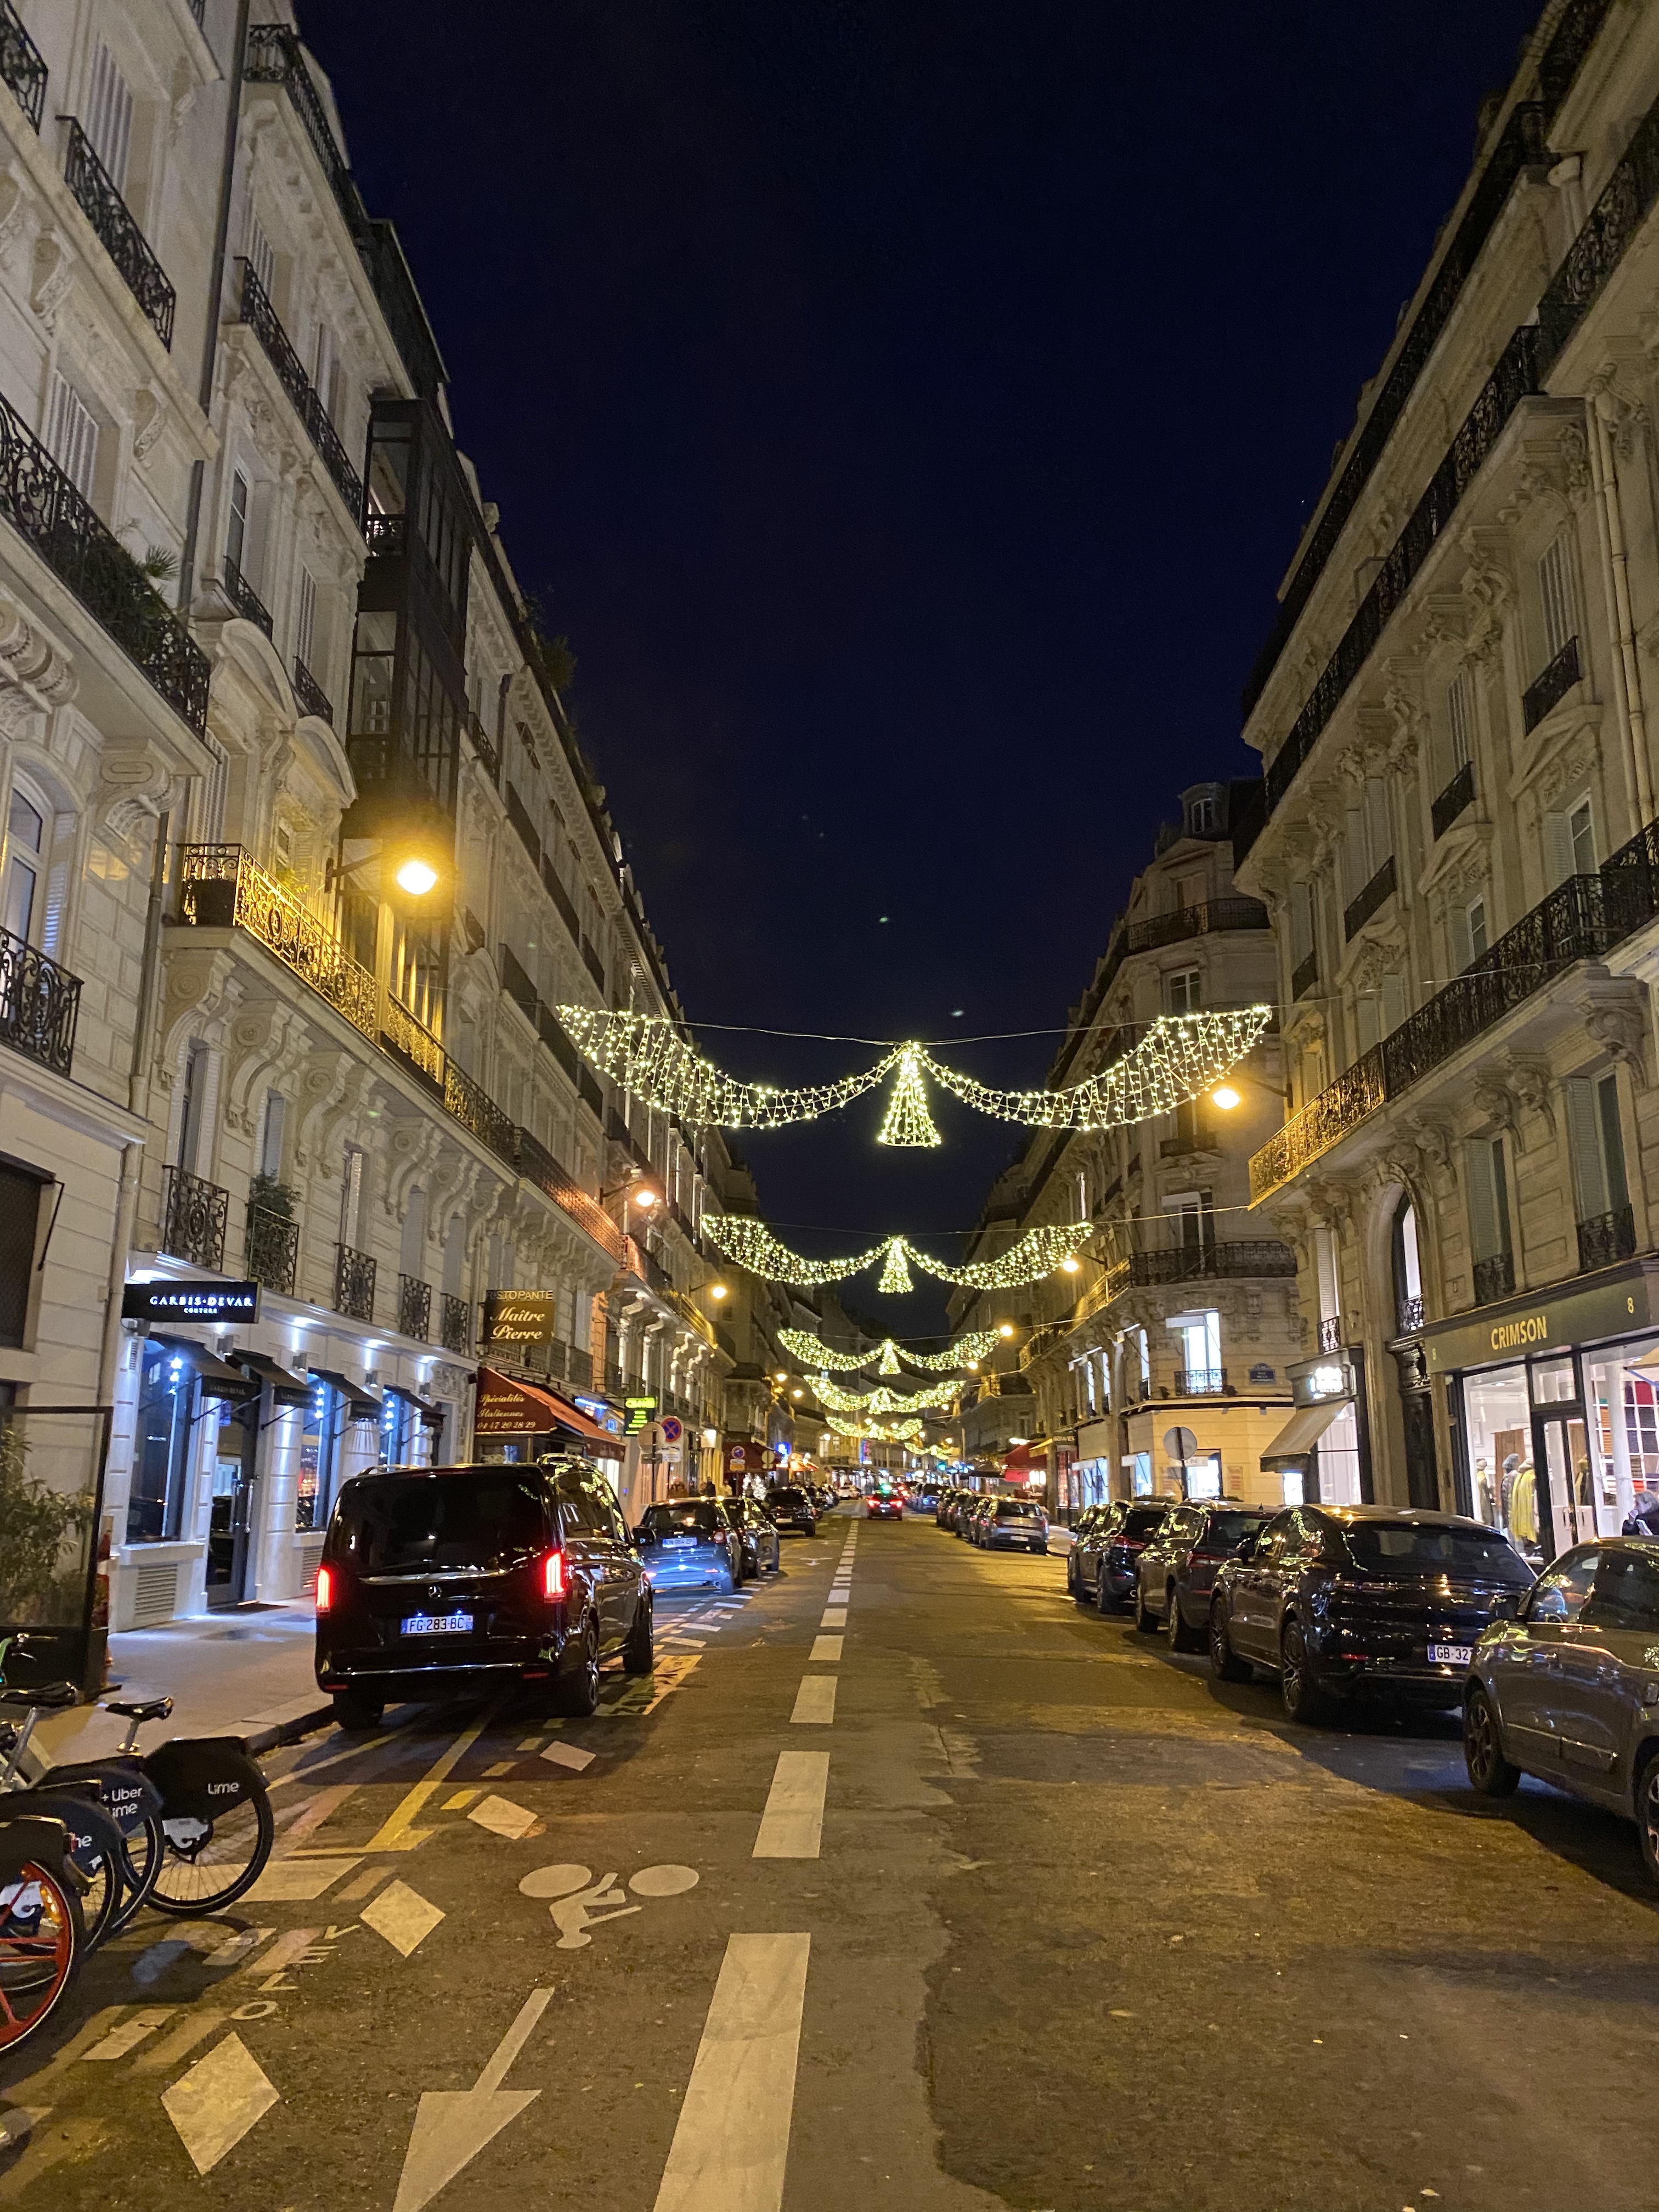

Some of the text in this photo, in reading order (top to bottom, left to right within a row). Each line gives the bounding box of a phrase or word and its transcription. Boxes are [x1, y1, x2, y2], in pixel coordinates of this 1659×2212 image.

[1627, 1297, 1634, 1313] 8
[490, 1307, 545, 1322] Maître
[490, 1324, 543, 1339] Pierre
[1491, 1316, 1548, 1350] CRIMSON
[409, 1617, 464, 1632] FG-283-BC
[1437, 1647, 1469, 1661] GB-32
[111, 1787, 143, 1802] Uber
[207, 1782, 239, 1795] Lime
[107, 1802, 137, 1817] ime
